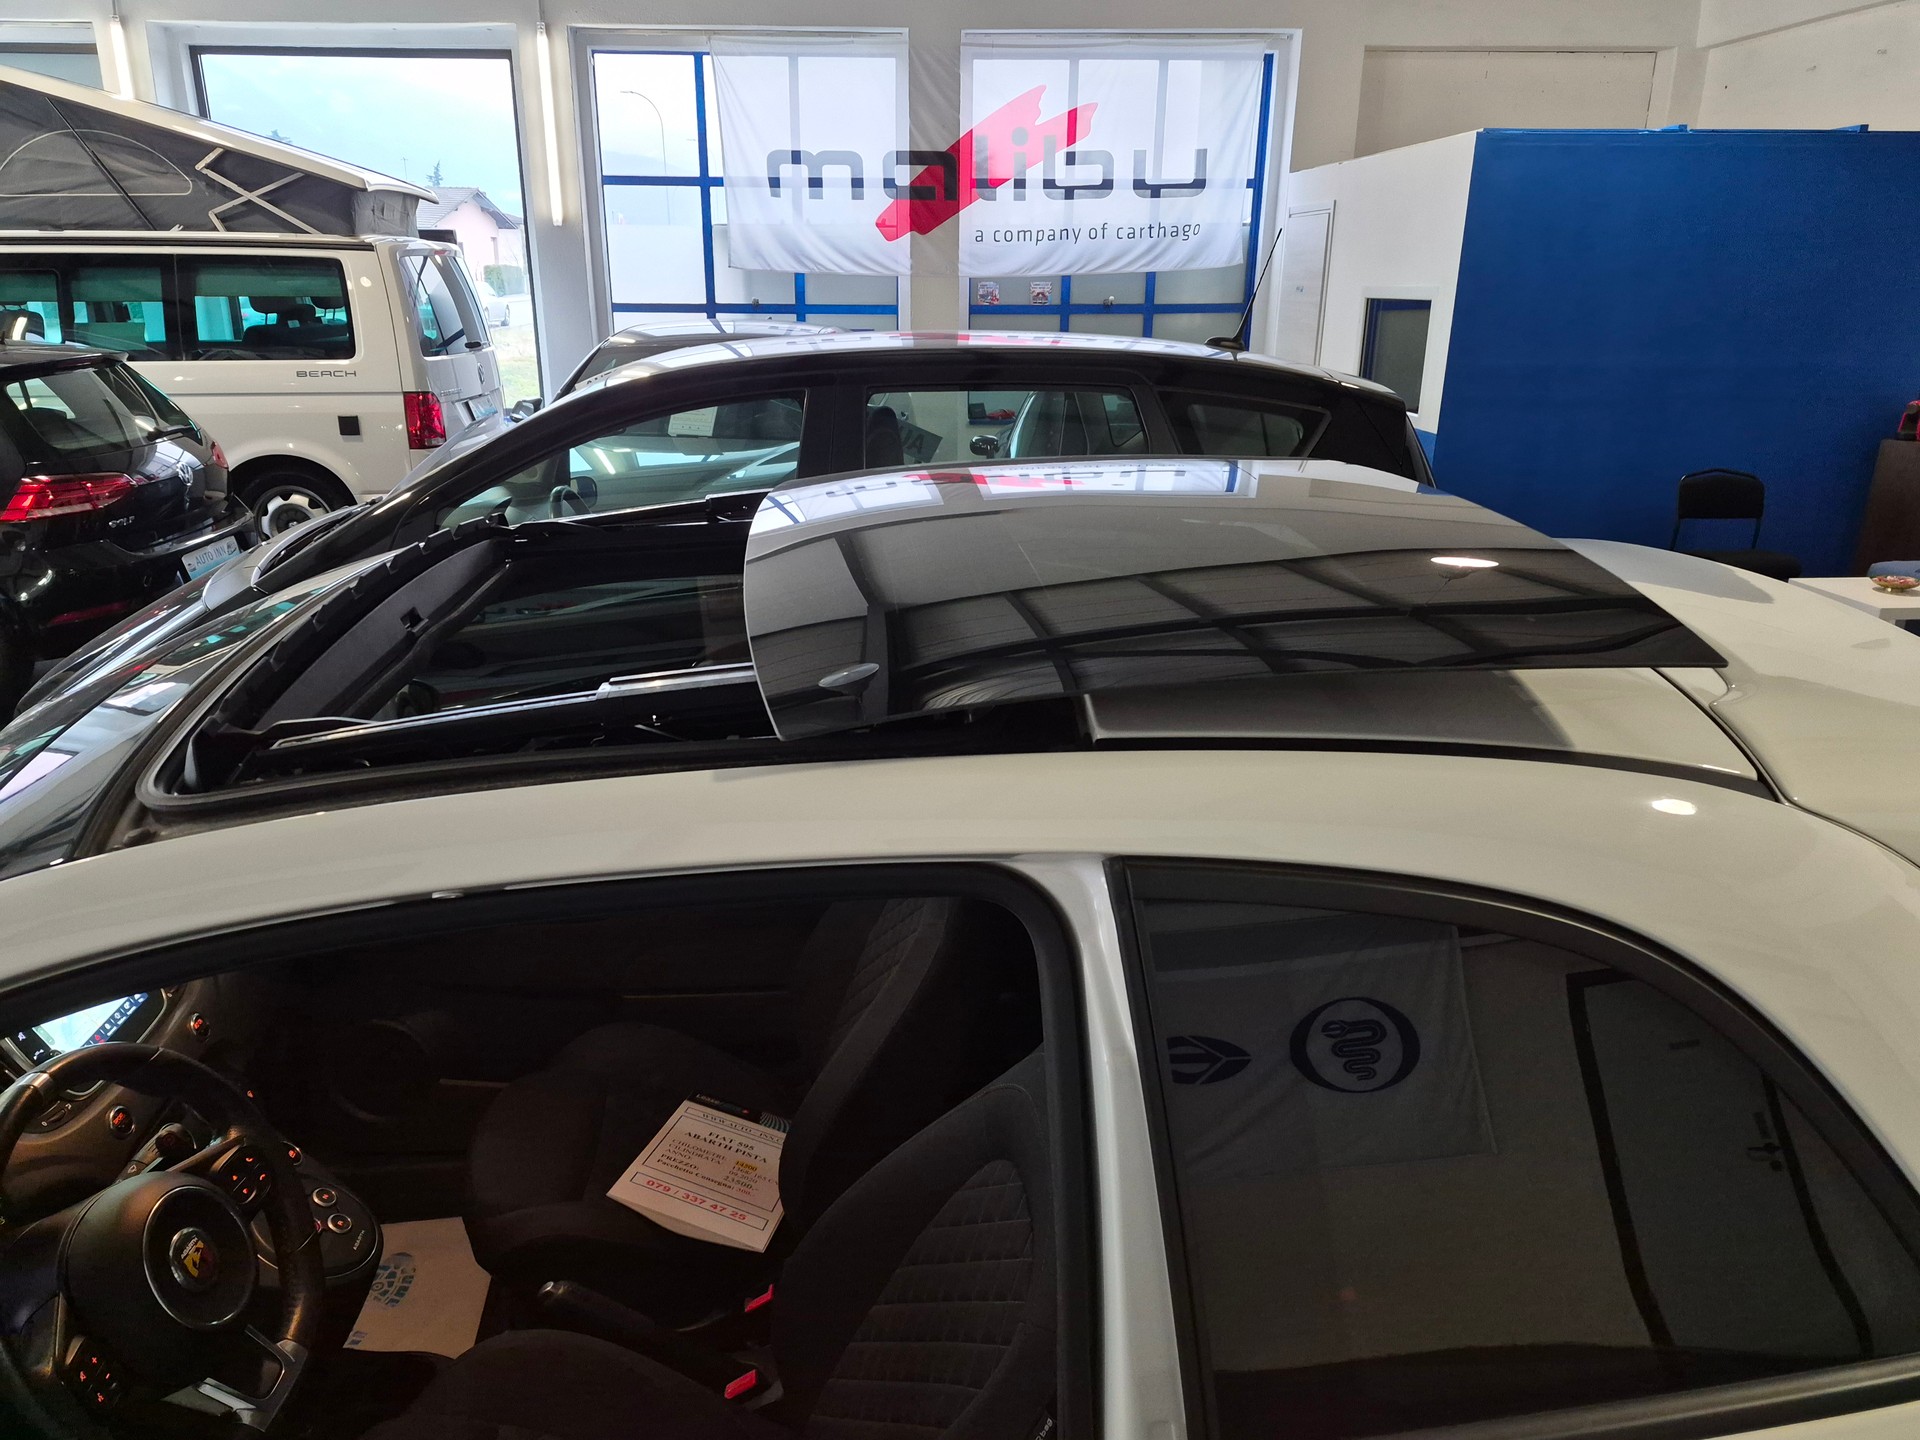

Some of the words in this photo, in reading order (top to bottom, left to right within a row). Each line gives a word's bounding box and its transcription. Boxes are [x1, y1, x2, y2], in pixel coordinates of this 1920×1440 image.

[766, 126, 1208, 202] malibu
[975, 229, 985, 242] a
[992, 227, 1082, 246] company
[1088, 222, 1108, 240] of
[1115, 222, 1202, 241] carthago
[296, 370, 358, 378] BEACH
[195, 551, 214, 567] AUTO
[213, 546, 227, 561] INN
[684, 1131, 734, 1152] ABARTH
[735, 1146, 767, 1164] PISTA
[708, 1131, 736, 1144] FIAT
[736, 1141, 755, 1151] 595
[661, 1153, 699, 1171] PREZZO:
[646, 1179, 672, 1193] 079
[681, 1192, 707, 1205] 337
[709, 1203, 727, 1212] 47
[729, 1210, 748, 1221] 25
